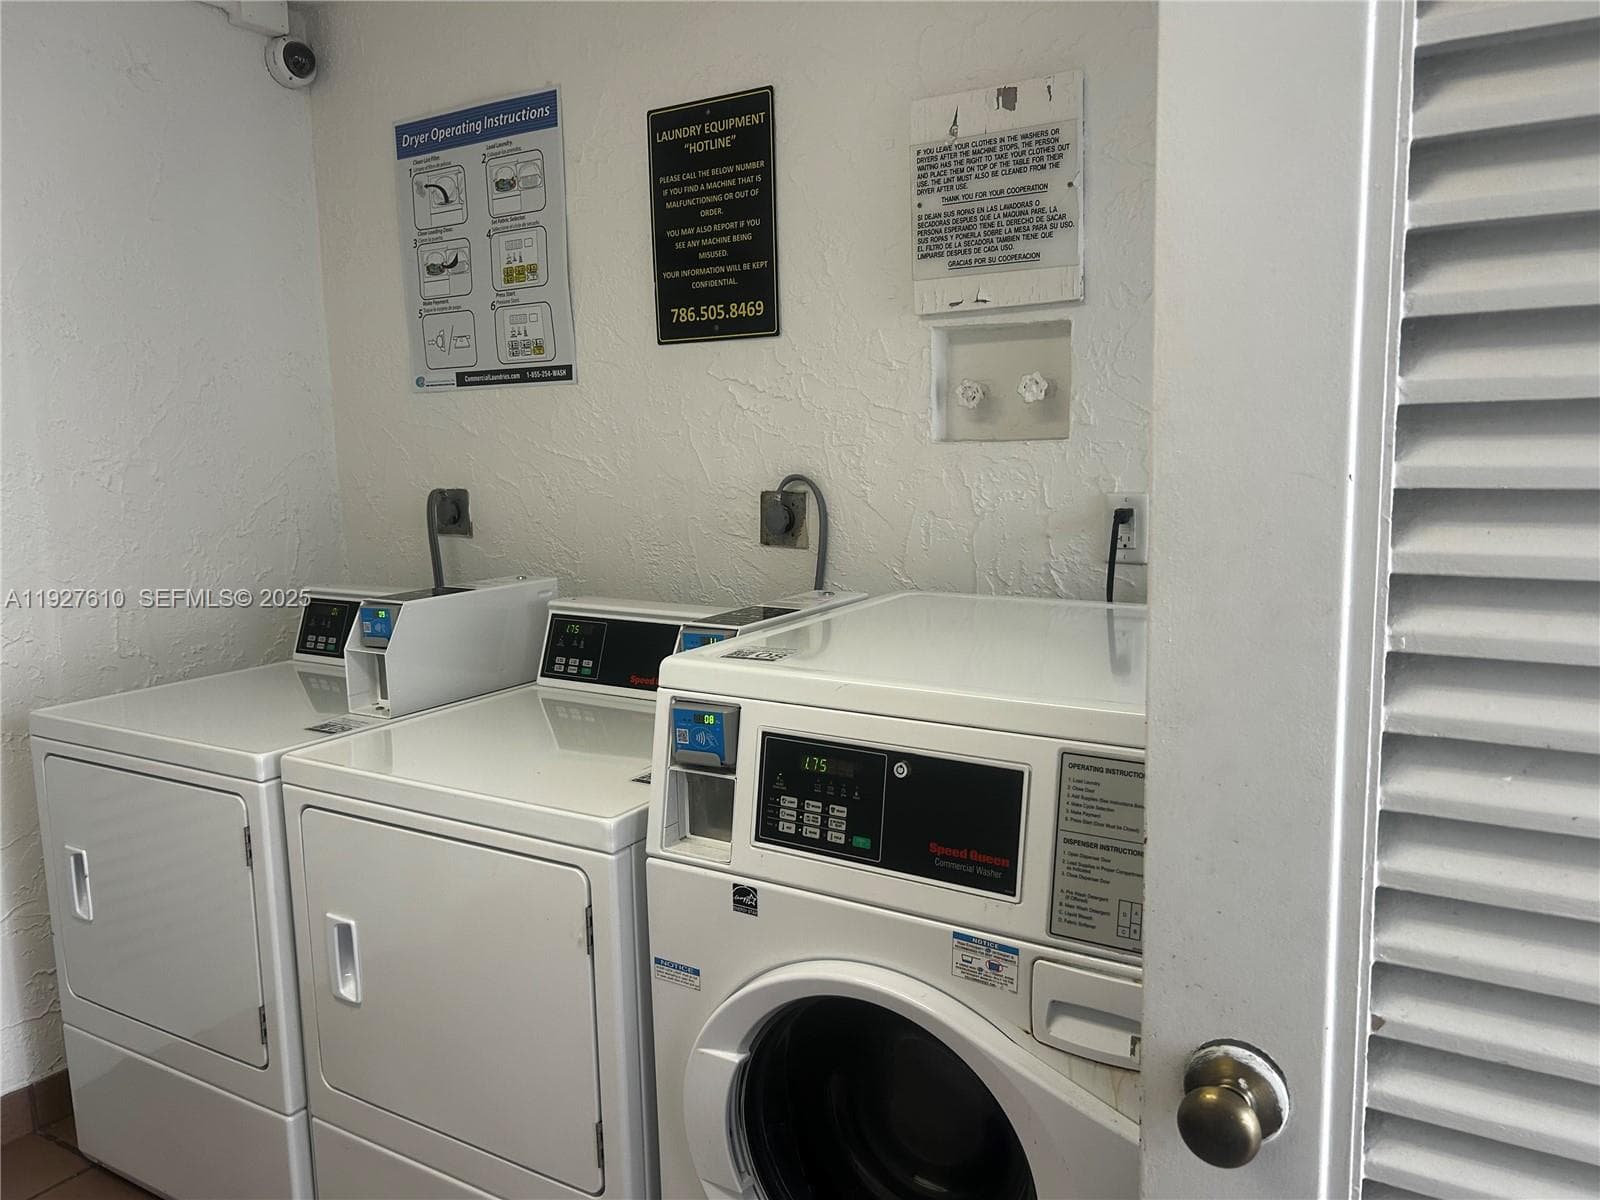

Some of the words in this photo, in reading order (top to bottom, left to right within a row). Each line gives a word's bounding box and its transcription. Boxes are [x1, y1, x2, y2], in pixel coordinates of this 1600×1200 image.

[402, 130, 428, 147] Dryer
[430, 119, 481, 141] Operating
[483, 105, 549, 130] Instructions
[656, 124, 701, 142] LAUNDRY
[704, 113, 765, 134] EQUIPMENT
[923, 147, 934, 155] YOU
[935, 144, 952, 153] LEAVE
[954, 142, 969, 150] YOUR
[970, 138, 997, 148] CLOTHES
[998, 136, 1005, 144] IN
[1007, 134, 1018, 143] THE
[1020, 130, 1048, 141] WASHERS
[1050, 128, 1059, 136] OR
[481, 153, 486, 164] 2
[916, 155, 938, 164] DRYERS
[939, 152, 957, 161] AFTER
[959, 150, 970, 158] THE
[971, 146, 997, 156] MACHINE
[998, 143, 1019, 153] STOPS,
[1021, 141, 1032, 149] THE
[1034, 138, 1059, 148] PERSON
[916, 162, 938, 172] WAITING
[939, 160, 951, 168] HAS
[953, 158, 964, 167] THE
[965, 156, 982, 165] RIGHT
[994, 152, 1008, 161] TAKE
[1010, 150, 1026, 159] YOUR
[1027, 146, 1055, 156] CLOTHES
[1057, 144, 1069, 152] OUT
[408, 168, 412, 178] 1
[659, 174, 680, 184] PLEASE
[681, 172, 696, 181] CALL
[698, 169, 709, 178] THE
[711, 165, 734, 176] BELOW
[735, 160, 764, 172] NUMBER
[929, 169, 947, 178] PLACE
[949, 167, 964, 175] THEM
[966, 165, 975, 173] ON
[976, 164, 988, 172] TOP
[989, 162, 997, 170] OF
[999, 161, 1010, 169] THE
[1012, 158, 1030, 167] TABLE
[1031, 156, 1044, 164] FOR
[1046, 153, 1063, 162] THEIR
[931, 178, 941, 186] THE
[942, 176, 954, 184] LINT
[956, 174, 972, 182] MUST
[974, 172, 989, 180] ALSO
[990, 170, 999, 178] BE
[1000, 166, 1027, 177] CLEANED
[1029, 164, 1046, 173] FROM
[1048, 162, 1060, 170] THE
[669, 187, 682, 195] YOU
[683, 185, 698, 193] FIND
[705, 179, 736, 190] MACHINE
[738, 176, 753, 185] THAT
[916, 187, 934, 196] DRYER
[936, 185, 954, 193] AFTER
[942, 194, 959, 202] THANK
[961, 192, 973, 200] YOU
[974, 191, 987, 199] FOR
[988, 189, 1005, 197] YOUR
[1006, 183, 1048, 195] COOPERATION
[665, 194, 722, 208] MALFUNCTIONING
[723, 192, 733, 200] OR
[734, 190, 748, 199] OUT
[749, 189, 758, 197] OF
[700, 208, 723, 217] ORDER.
[917, 218, 950, 229] SECADORAS
[951, 215, 977, 225] DESPUES
[979, 214, 991, 222] QUE
[1002, 209, 1029, 219] MAQUINA
[1048, 206, 1057, 214] LA
[924, 212, 942, 220] DEJAN
[943, 210, 955, 218] SUS
[956, 208, 975, 216] ROPAS
[976, 206, 984, 214] EN
[986, 205, 997, 213] LAS
[999, 201, 1033, 211] LAVADORAS
[486, 229, 491, 238] 4
[666, 229, 679, 238] YOU
[680, 227, 694, 236] MAY
[695, 225, 712, 234] ALSO
[713, 221, 737, 231] REPORT
[739, 220, 744, 228] IF
[746, 218, 760, 227] YOU
[917, 227, 942, 236] PERSONA
[943, 223, 977, 234] ESPERANDO
[979, 221, 995, 230] TIENE
[996, 220, 1004, 228] EL
[1005, 217, 1034, 227] DERECHO
[1035, 216, 1044, 224] DE
[1046, 214, 1066, 223] SACAR
[413, 238, 418, 249] 3
[686, 240, 699, 248] ANY
[701, 236, 730, 246] MACHINE
[732, 233, 752, 242] BEING
[698, 250, 728, 259] MISUSED.
[917, 251, 944, 260] LIMPIARSE
[946, 248, 972, 257] DESPUES
[983, 245, 998, 254] CADA
[1000, 244, 1014, 252] USO.
[948, 259, 972, 267] GRACIAS
[973, 257, 986, 265] POR
[987, 256, 996, 264] SU
[997, 252, 1040, 263] COOPERACION
[662, 271, 679, 279] YOUR
[680, 265, 725, 277] INFORMATION
[725, 264, 740, 272] WILL
[751, 261, 767, 269] KEPT
[691, 278, 738, 289] CONFIDENTIAL.
[418, 309, 423, 319] 5
[490, 300, 496, 311] 6
[671, 301, 763, 323] 786.505.8469
[630, 674, 656, 686] Speed
[704, 715, 714, 724] 08
[1068, 762, 1104, 773] OPERATING
[1063, 837, 1098, 849] DISPENSER
[929, 842, 967, 861] Speed
[969, 849, 1009, 867] Queen
[934, 858, 974, 874] Commercial
[975, 864, 1002, 879] Washer
[972, 938, 999, 949] NOTICE
[660, 959, 691, 973] NOTICE
